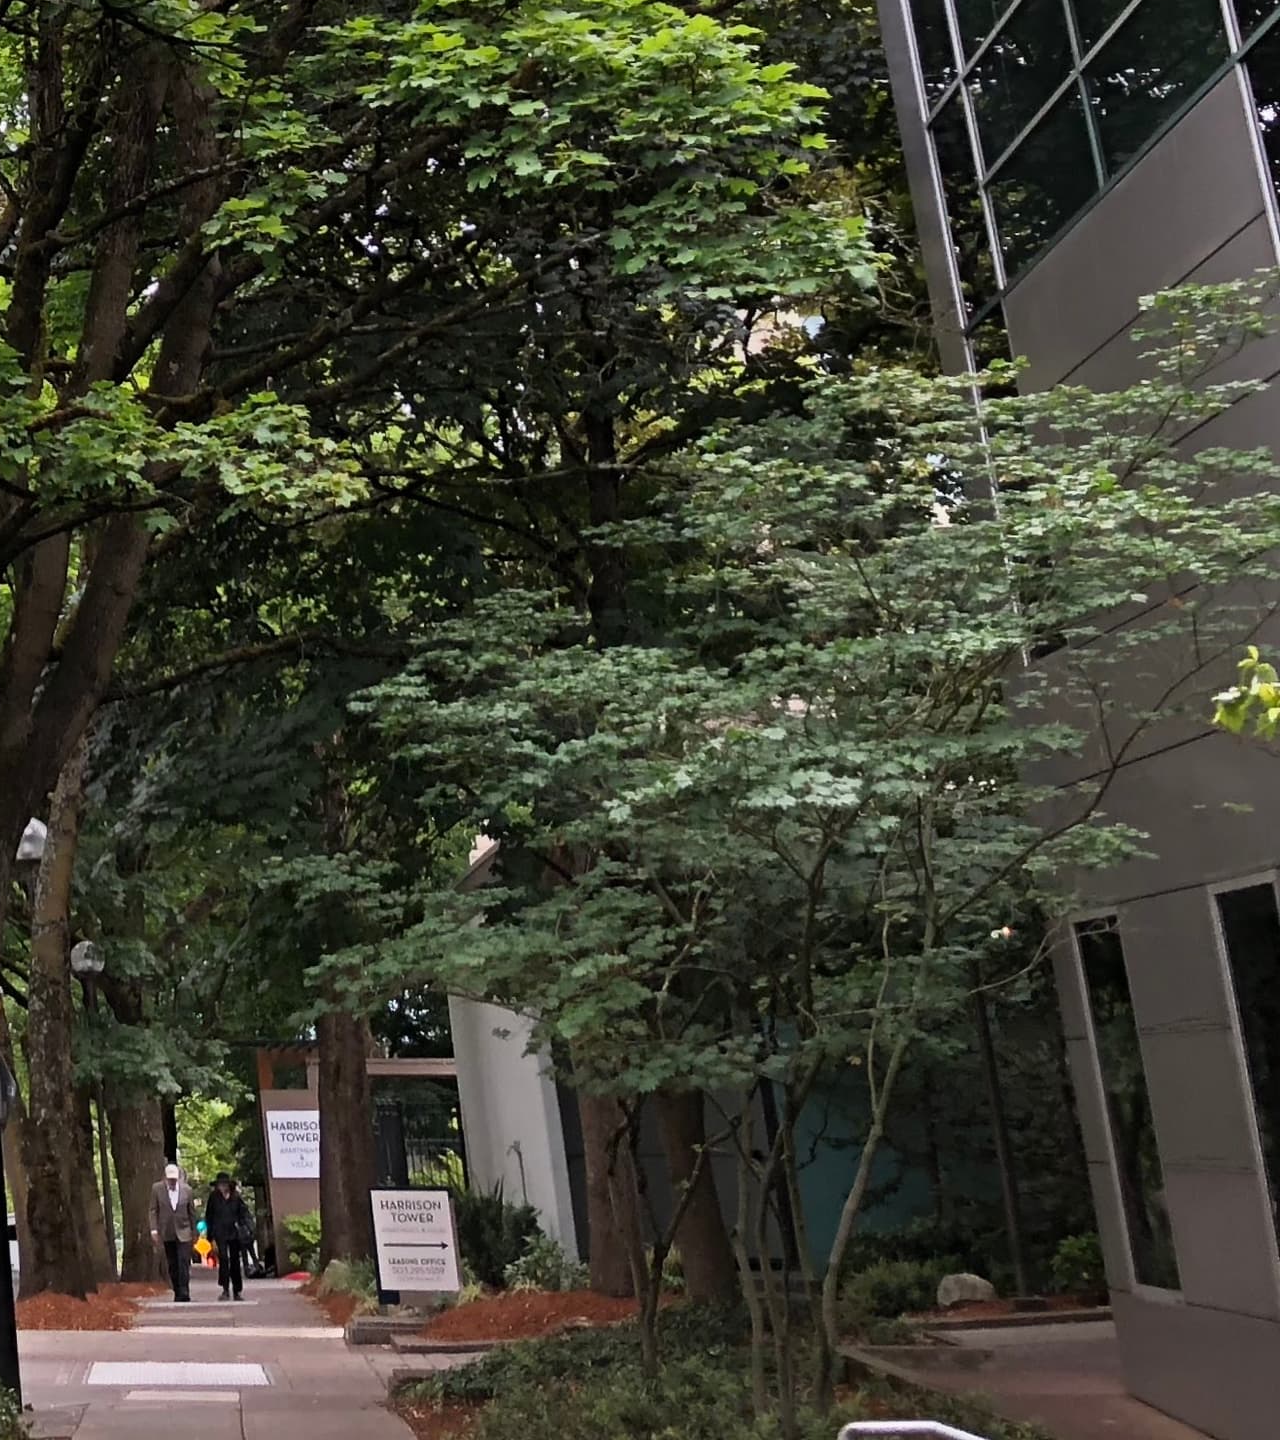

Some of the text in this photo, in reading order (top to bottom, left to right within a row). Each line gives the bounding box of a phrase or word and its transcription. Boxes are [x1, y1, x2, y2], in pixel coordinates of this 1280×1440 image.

[271, 1121, 320, 1131] HARRISO
[280, 1132, 320, 1142] TOWER
[380, 1200, 442, 1210] HARRISON
[391, 1213, 434, 1223] TOWER
